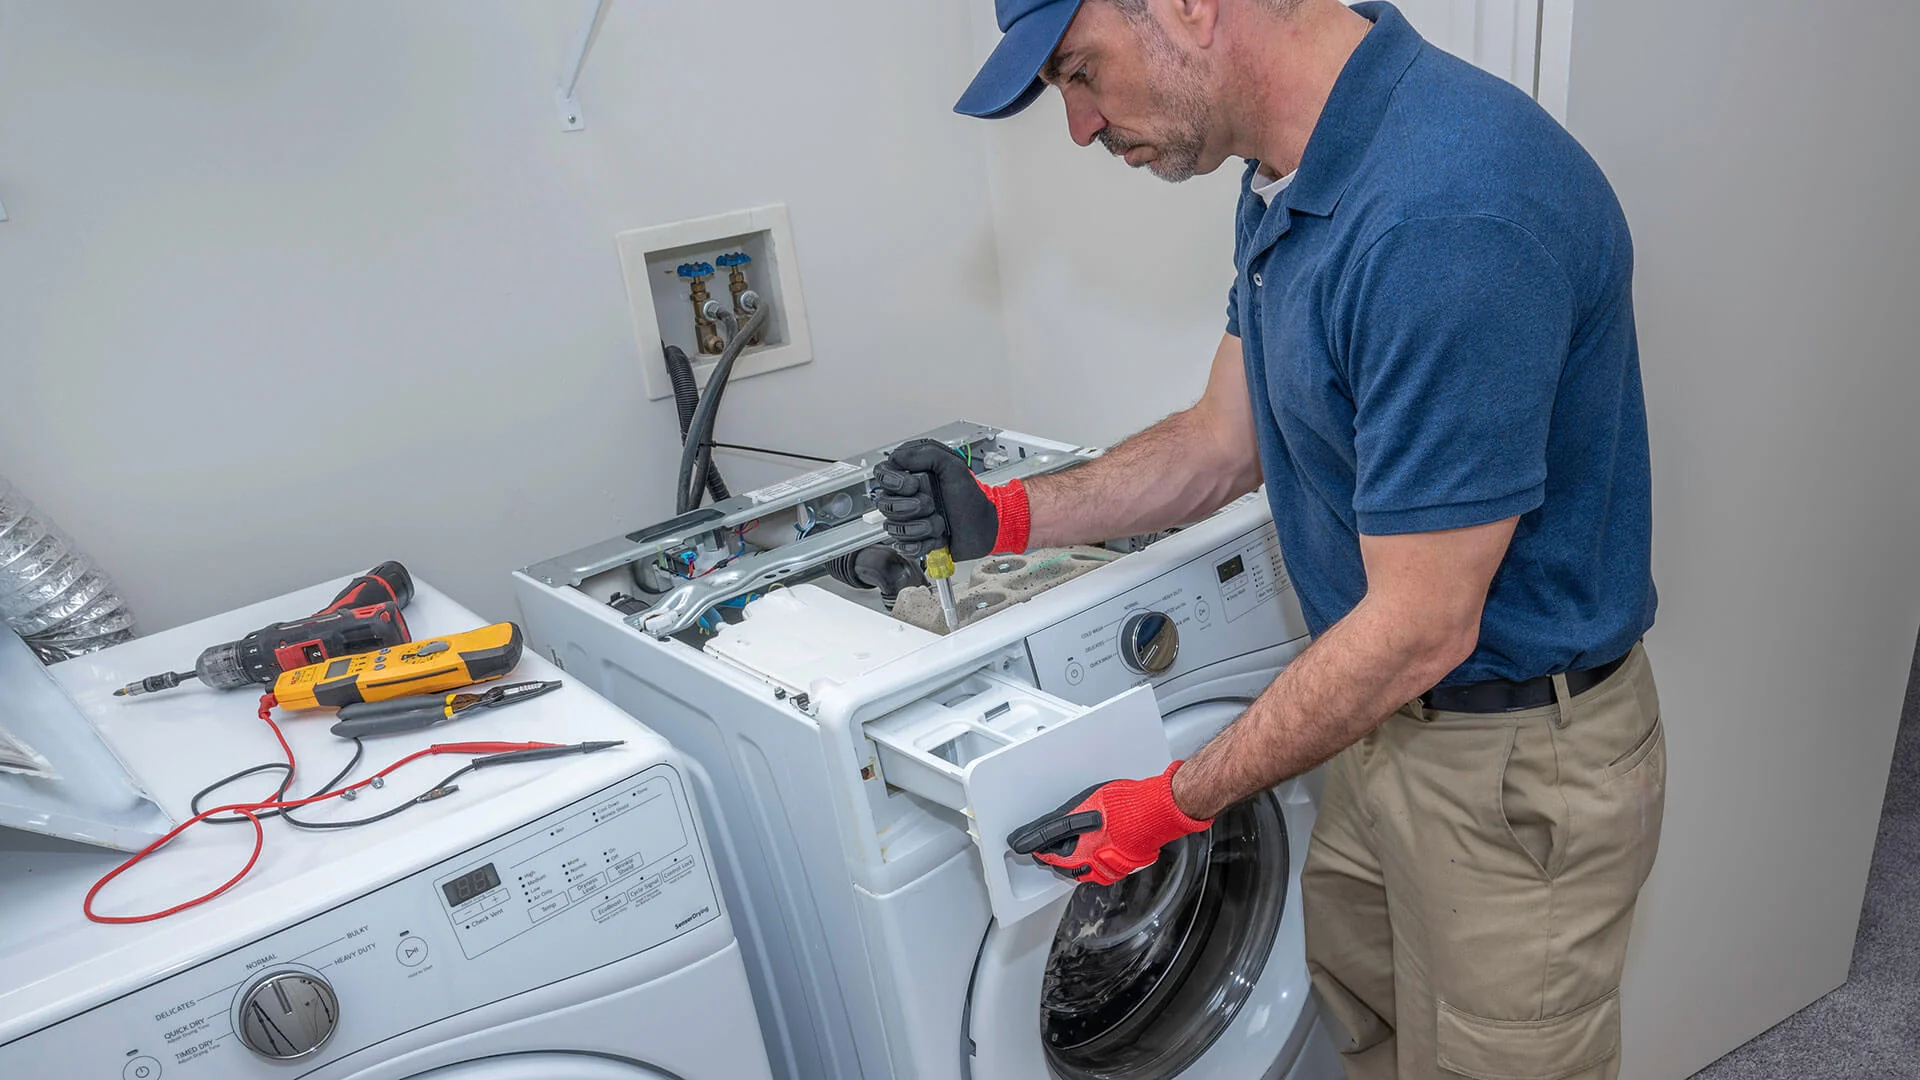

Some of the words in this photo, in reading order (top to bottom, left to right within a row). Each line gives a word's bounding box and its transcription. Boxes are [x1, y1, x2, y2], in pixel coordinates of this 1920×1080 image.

[615, 858, 634, 870] Wrinkle
[618, 864, 634, 875] Shield
[663, 866, 681, 878] Control
[682, 859, 693, 868] Lock
[576, 877, 598, 891] Dryness
[582, 884, 597, 894] Level
[630, 887, 643, 898] Cycle
[643, 879, 659, 891] Signal
[471, 915, 489, 928] Check
[490, 908, 504, 918] Vent
[674, 906, 709, 930] SensorDrying
[346, 925, 369, 940] BULKY
[246, 953, 278, 971] NORMAL
[334, 951, 357, 966] HEAVY
[358, 942, 377, 956] DUTY
[155, 999, 196, 1021] DELICATES
[164, 1025, 189, 1040] QUICK
[189, 1018, 205, 1029] DRY
[175, 1046, 198, 1060] TIMED
[198, 1039, 214, 1050] DRY
[193, 1049, 209, 1058] Drying
